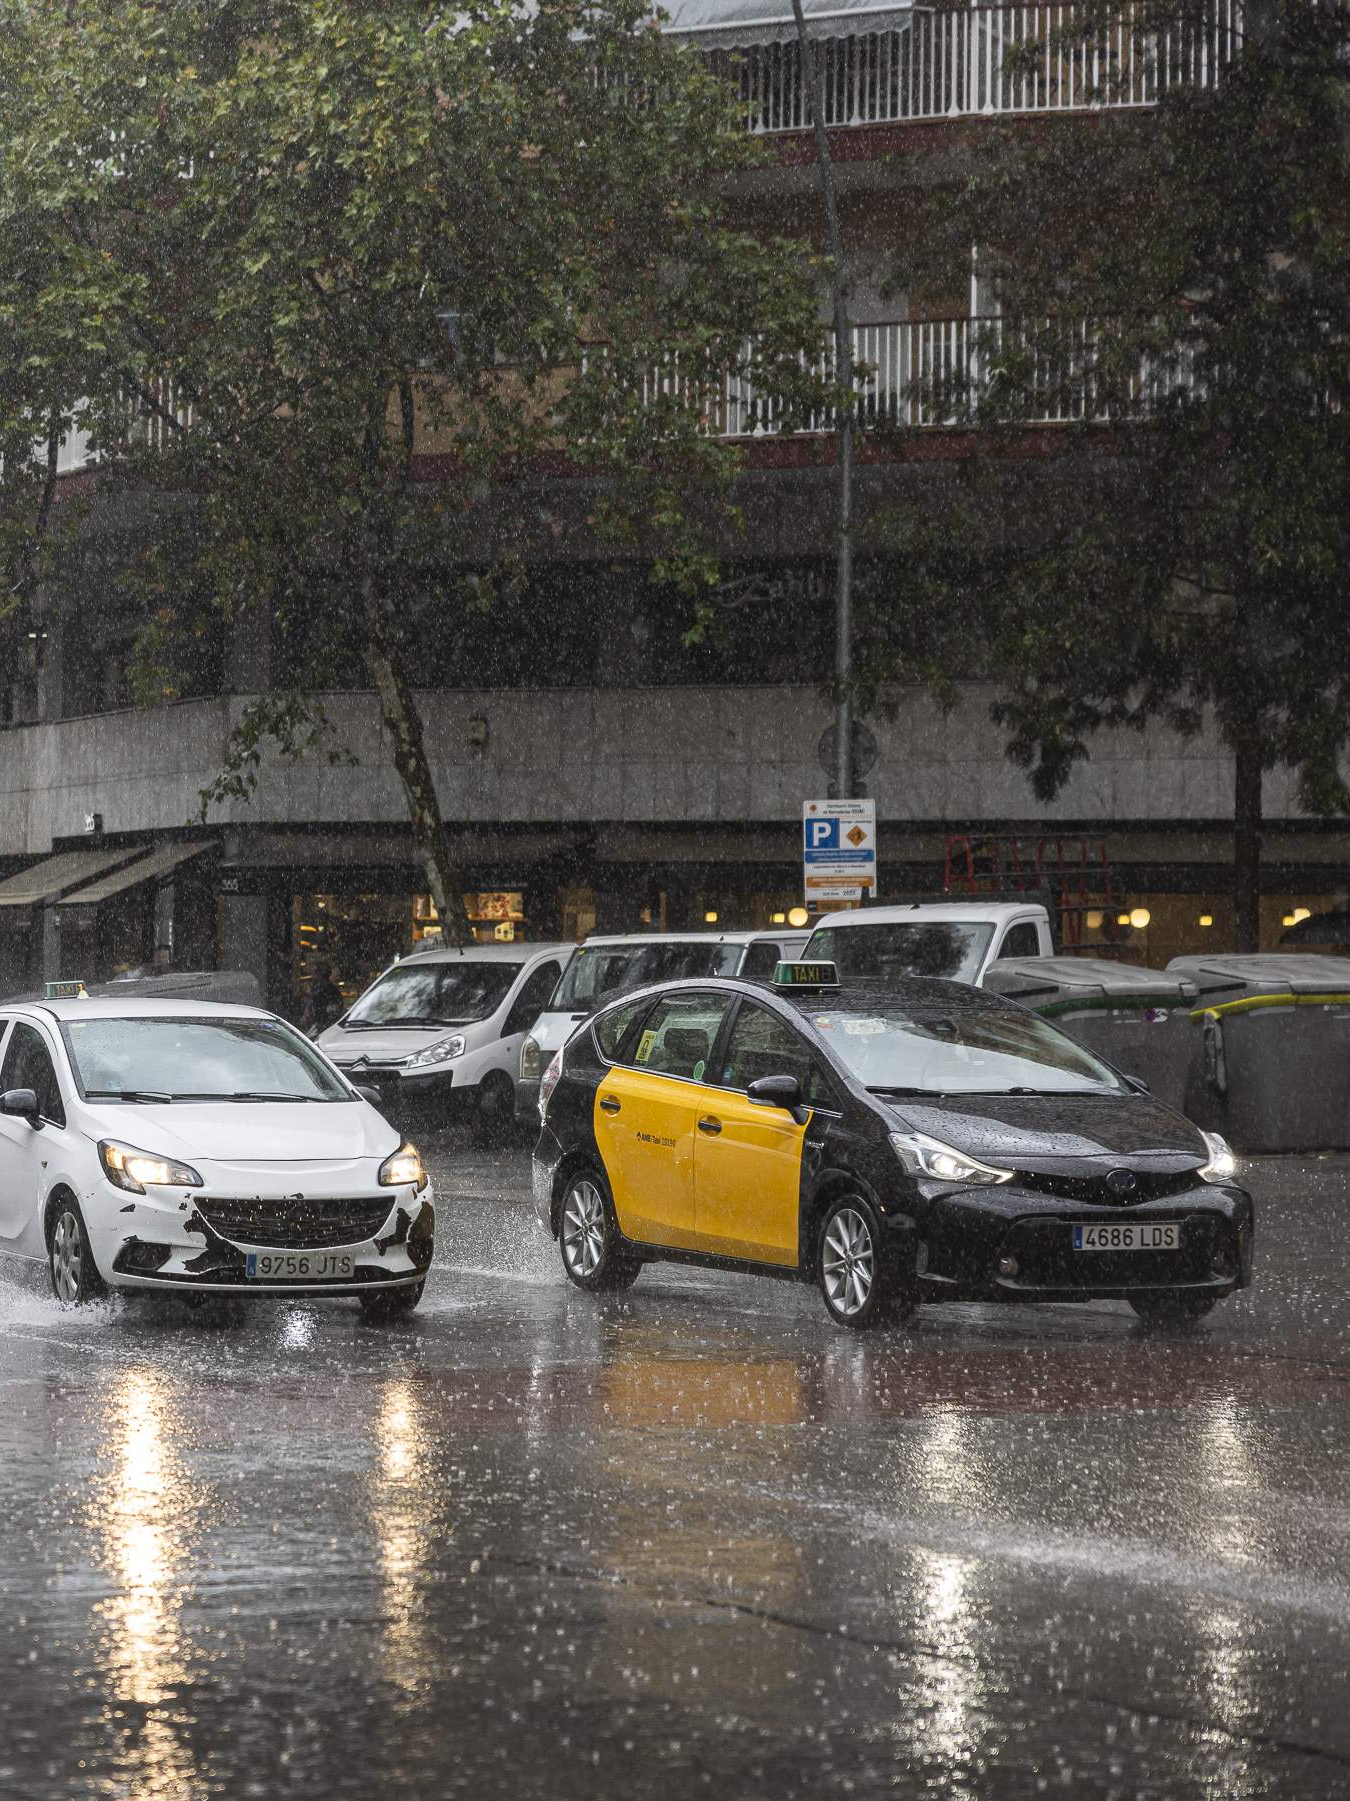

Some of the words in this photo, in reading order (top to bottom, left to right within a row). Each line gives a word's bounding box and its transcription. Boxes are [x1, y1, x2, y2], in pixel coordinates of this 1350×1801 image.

[813, 822, 831, 847] P
[793, 966, 819, 982] TAXI
[1086, 1228, 1133, 1247] 4686
[1140, 1228, 1174, 1247] LDS
[261, 1256, 310, 1275] 9756
[317, 1256, 351, 1274] JTS
